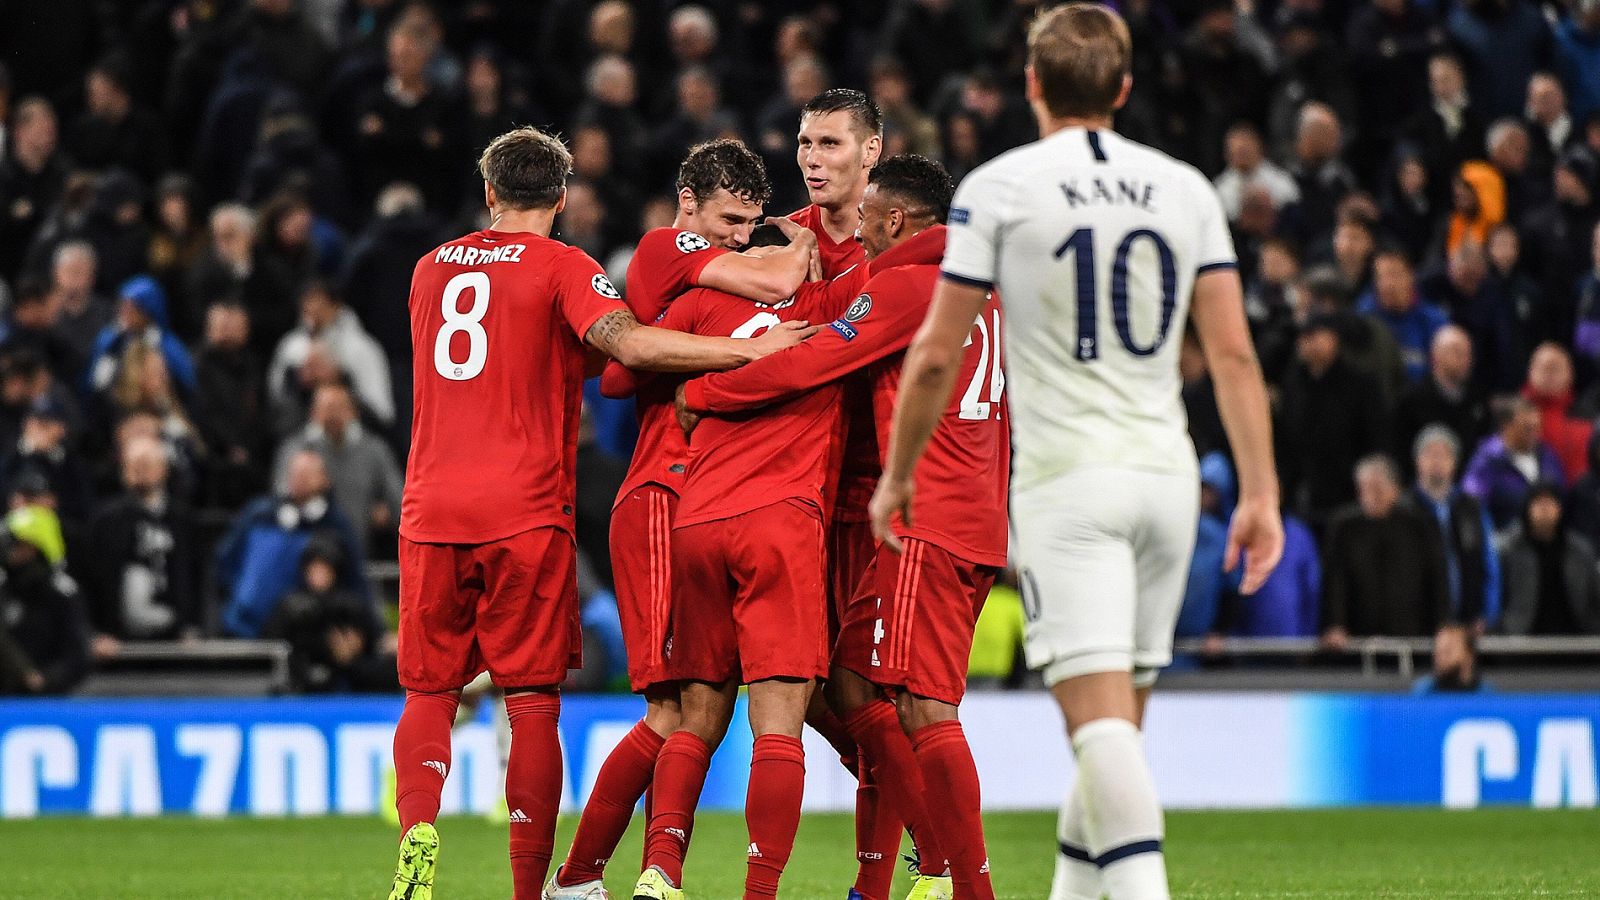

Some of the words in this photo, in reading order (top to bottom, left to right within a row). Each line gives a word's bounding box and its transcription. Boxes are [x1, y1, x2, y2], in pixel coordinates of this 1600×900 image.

[1060, 177, 1158, 212] KANE
[433, 271, 491, 381] 8
[1053, 228, 1177, 360] 10
[858, 852, 882, 860] FCB
